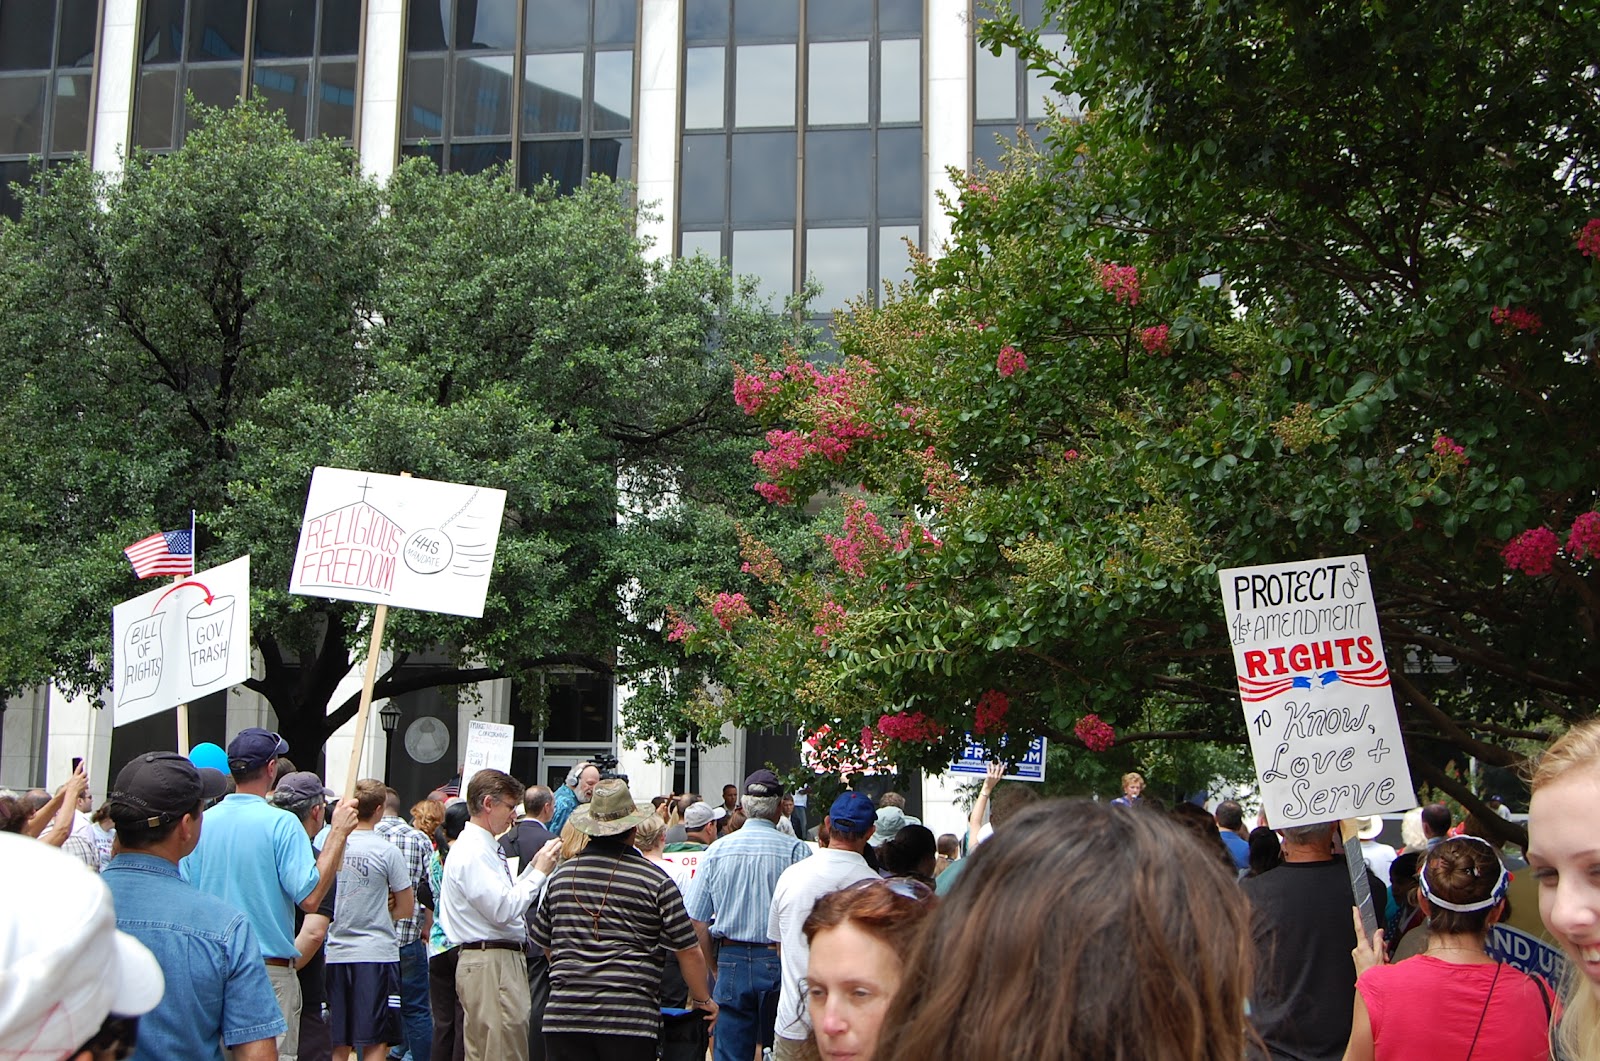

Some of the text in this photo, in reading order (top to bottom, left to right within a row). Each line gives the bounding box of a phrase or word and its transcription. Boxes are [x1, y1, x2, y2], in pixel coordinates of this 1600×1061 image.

[305, 505, 404, 555] RELIGIOUS
[412, 534, 440, 555] HHS
[299, 548, 396, 592] FREEDOM
[406, 548, 440, 567] MANDATE
[1234, 561, 1365, 610] PROTECT OUR
[131, 622, 158, 645] BILL
[1232, 602, 1367, 645] 1st AMENDMENT
[137, 641, 151, 659] OF
[192, 641, 228, 667] TRASH
[1243, 635, 1375, 679] RIGHTS
[126, 657, 162, 685] RIGHTS
[1253, 701, 1376, 741] TO Know,
[1262, 742, 1356, 784] Love
[1282, 777, 1395, 820] Serve
